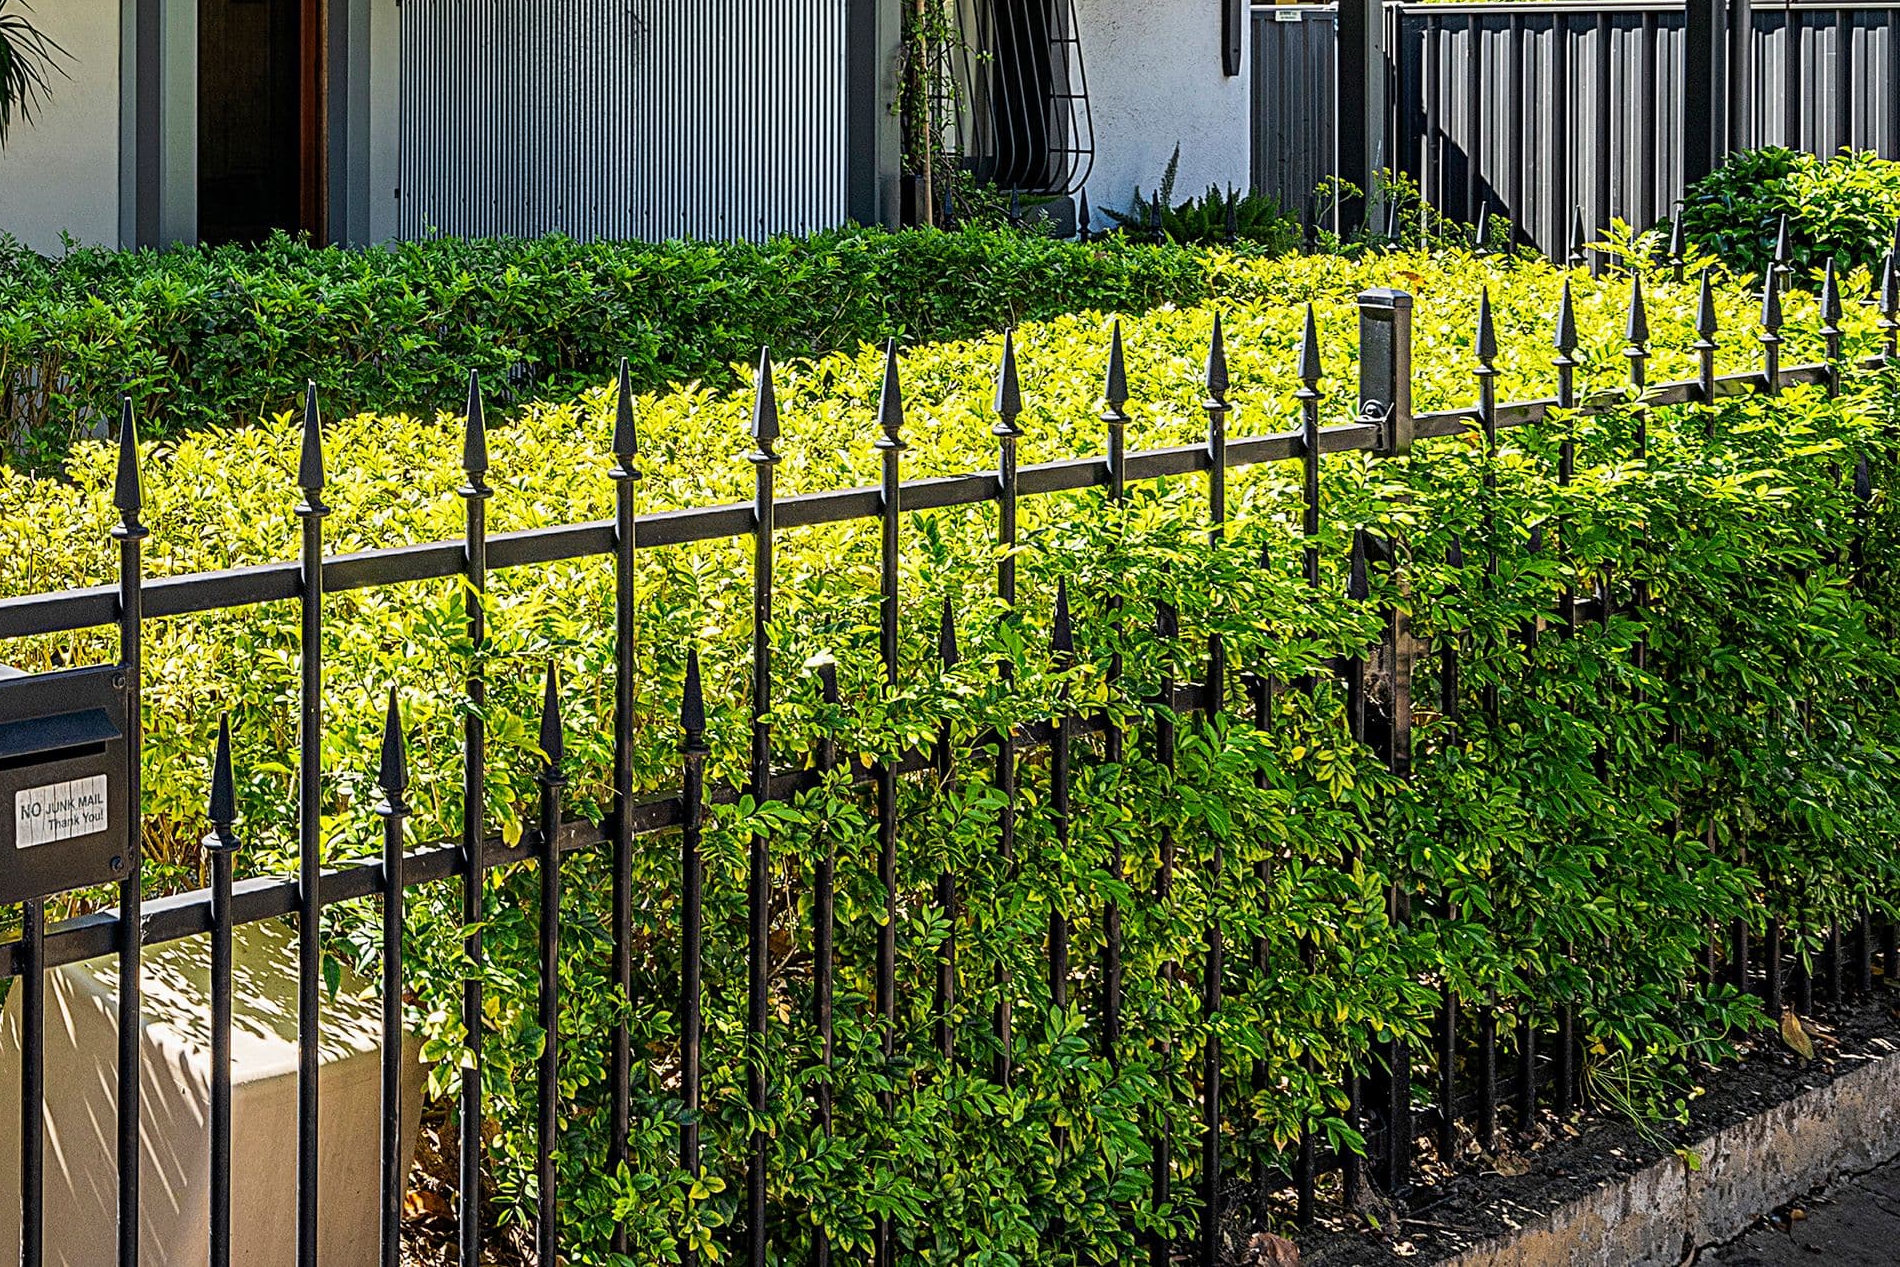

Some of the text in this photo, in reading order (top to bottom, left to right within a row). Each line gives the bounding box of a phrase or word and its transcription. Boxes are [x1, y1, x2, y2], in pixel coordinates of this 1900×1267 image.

[21, 793, 104, 820] NO JUNK MAIL
[48, 809, 104, 830] Thank You!
